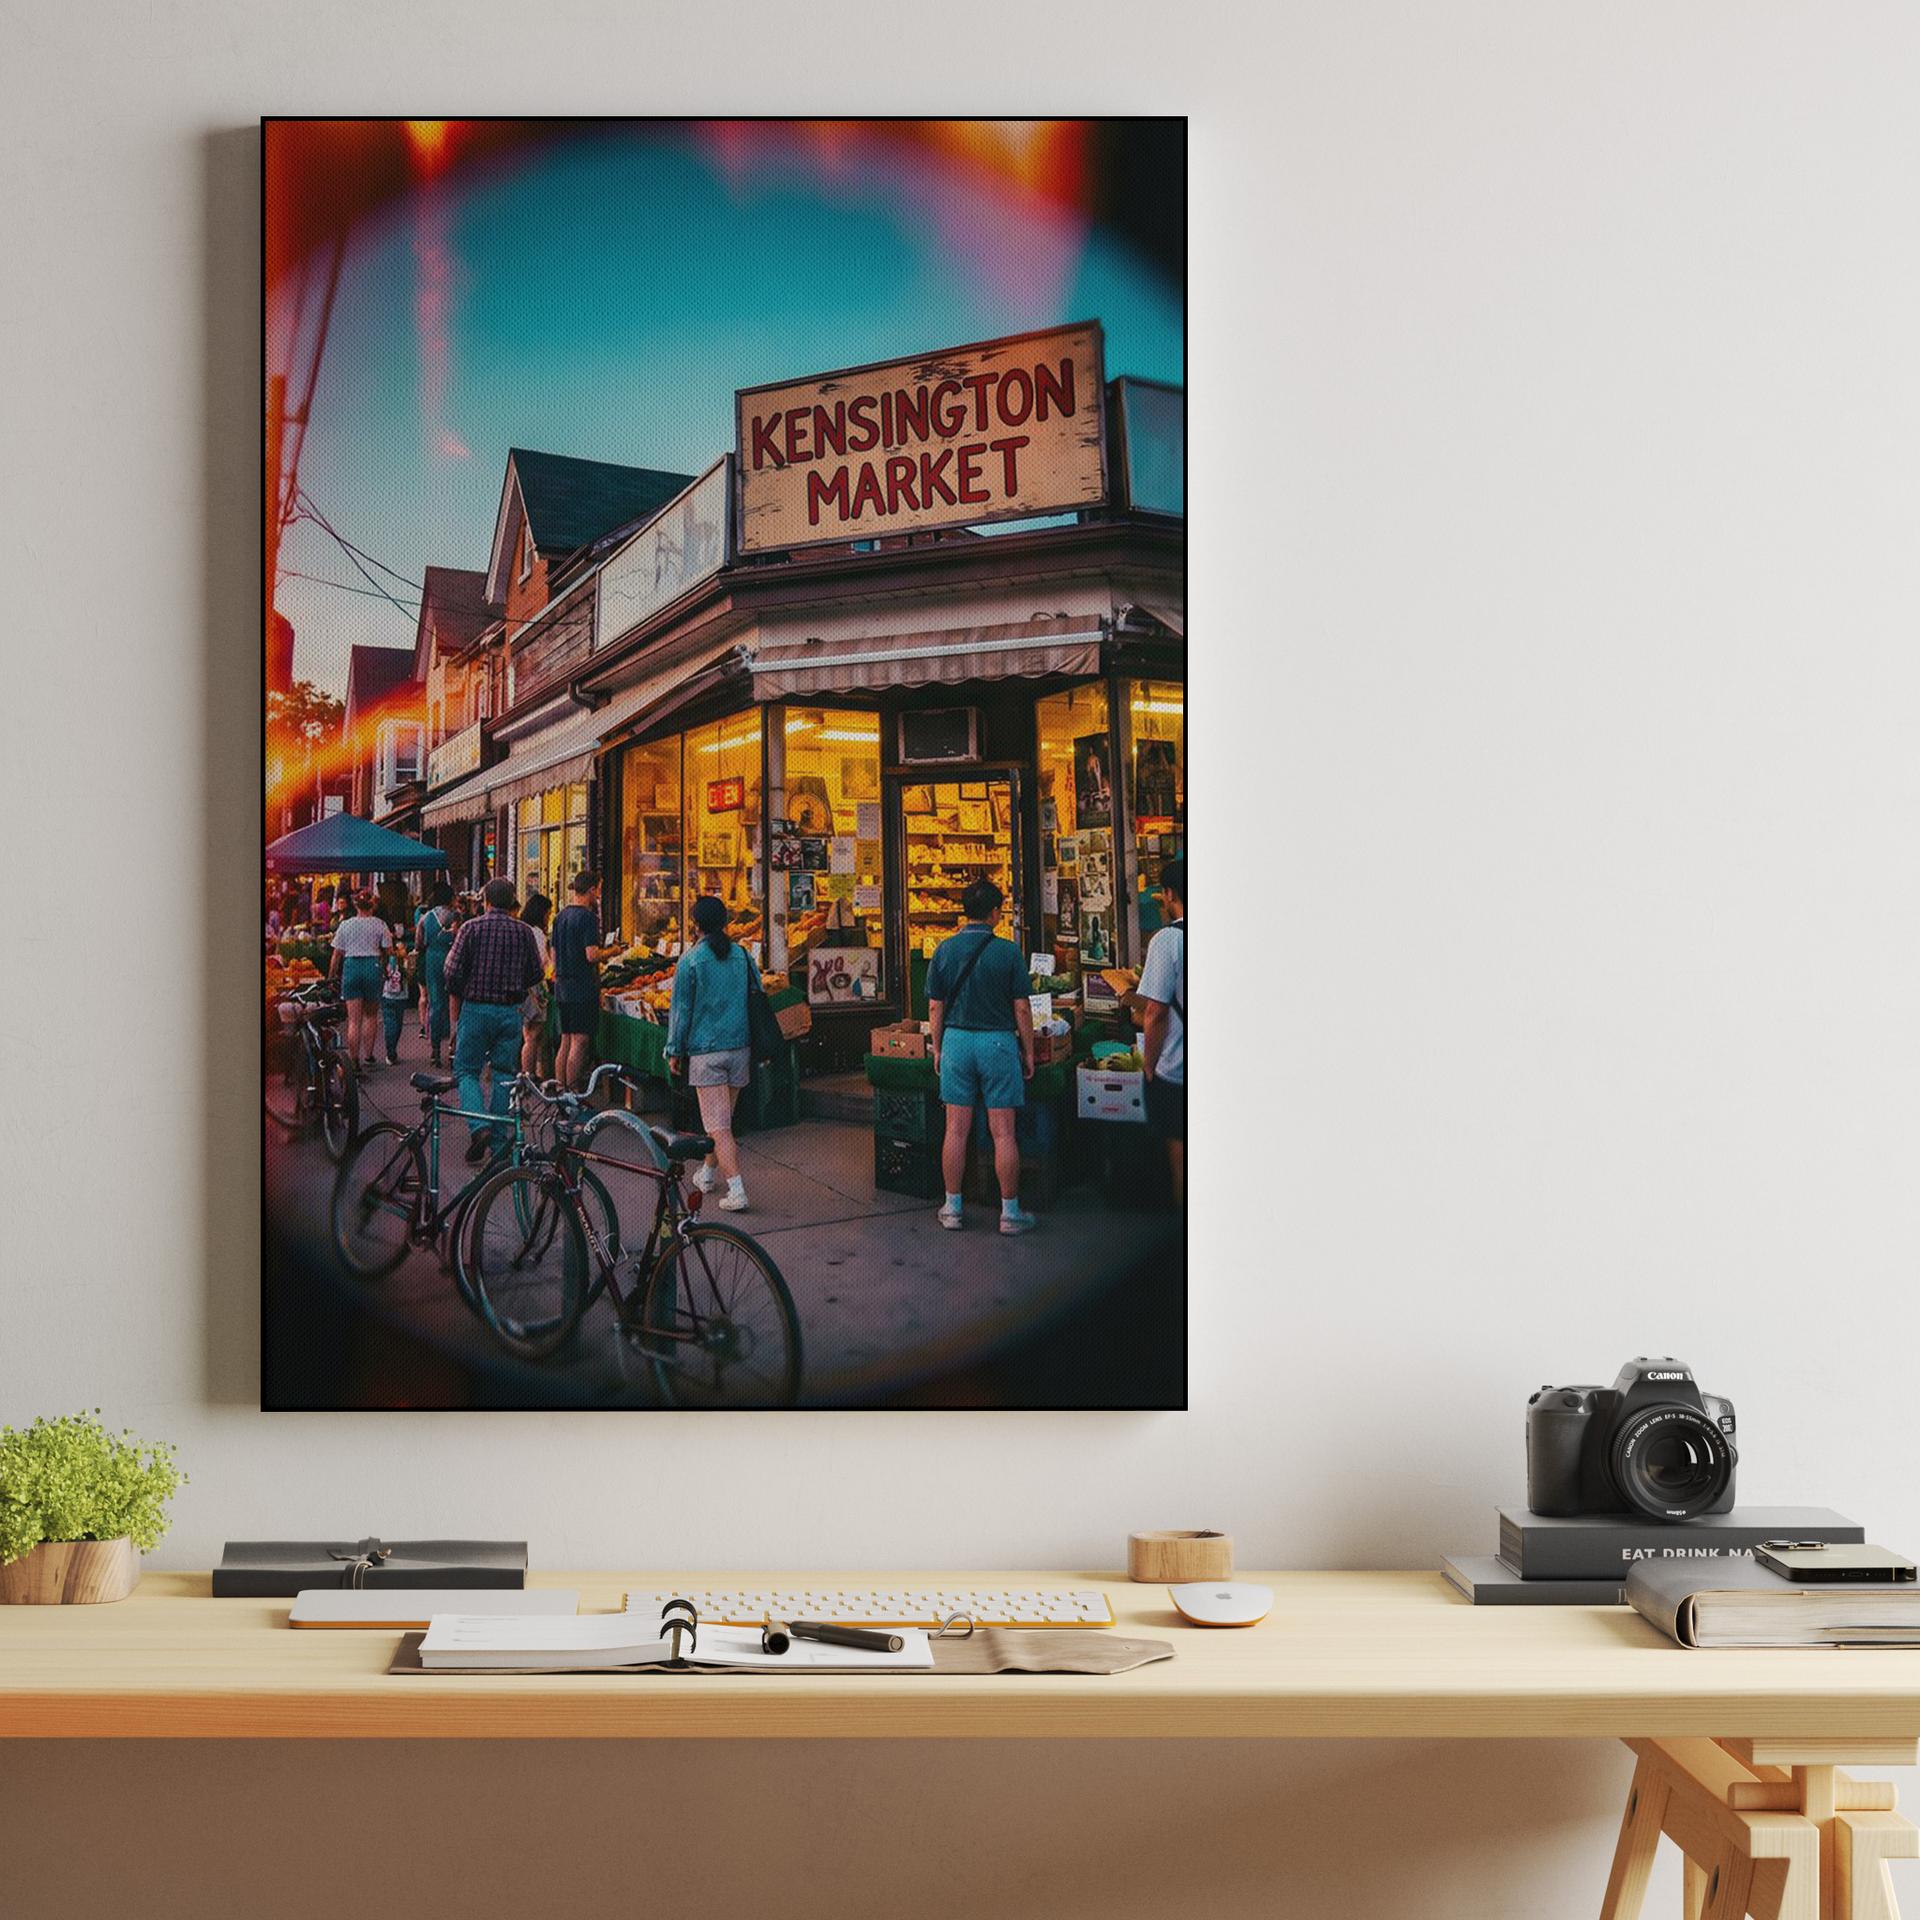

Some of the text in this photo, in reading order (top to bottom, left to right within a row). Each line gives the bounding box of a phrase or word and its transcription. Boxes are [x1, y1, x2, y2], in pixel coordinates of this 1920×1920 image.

[752, 357, 1077, 471] KENSINGTON
[807, 435, 1031, 526] MARKET
[1647, 1371, 1683, 1380] Canon
[1625, 1438, 1636, 1458] CANON
[1635, 1423, 1649, 1438] ZOOM
[1649, 1416, 1663, 1425] LENS
[1622, 1548, 1655, 1560] EAT
[1663, 1548, 1720, 1558] DRINK
